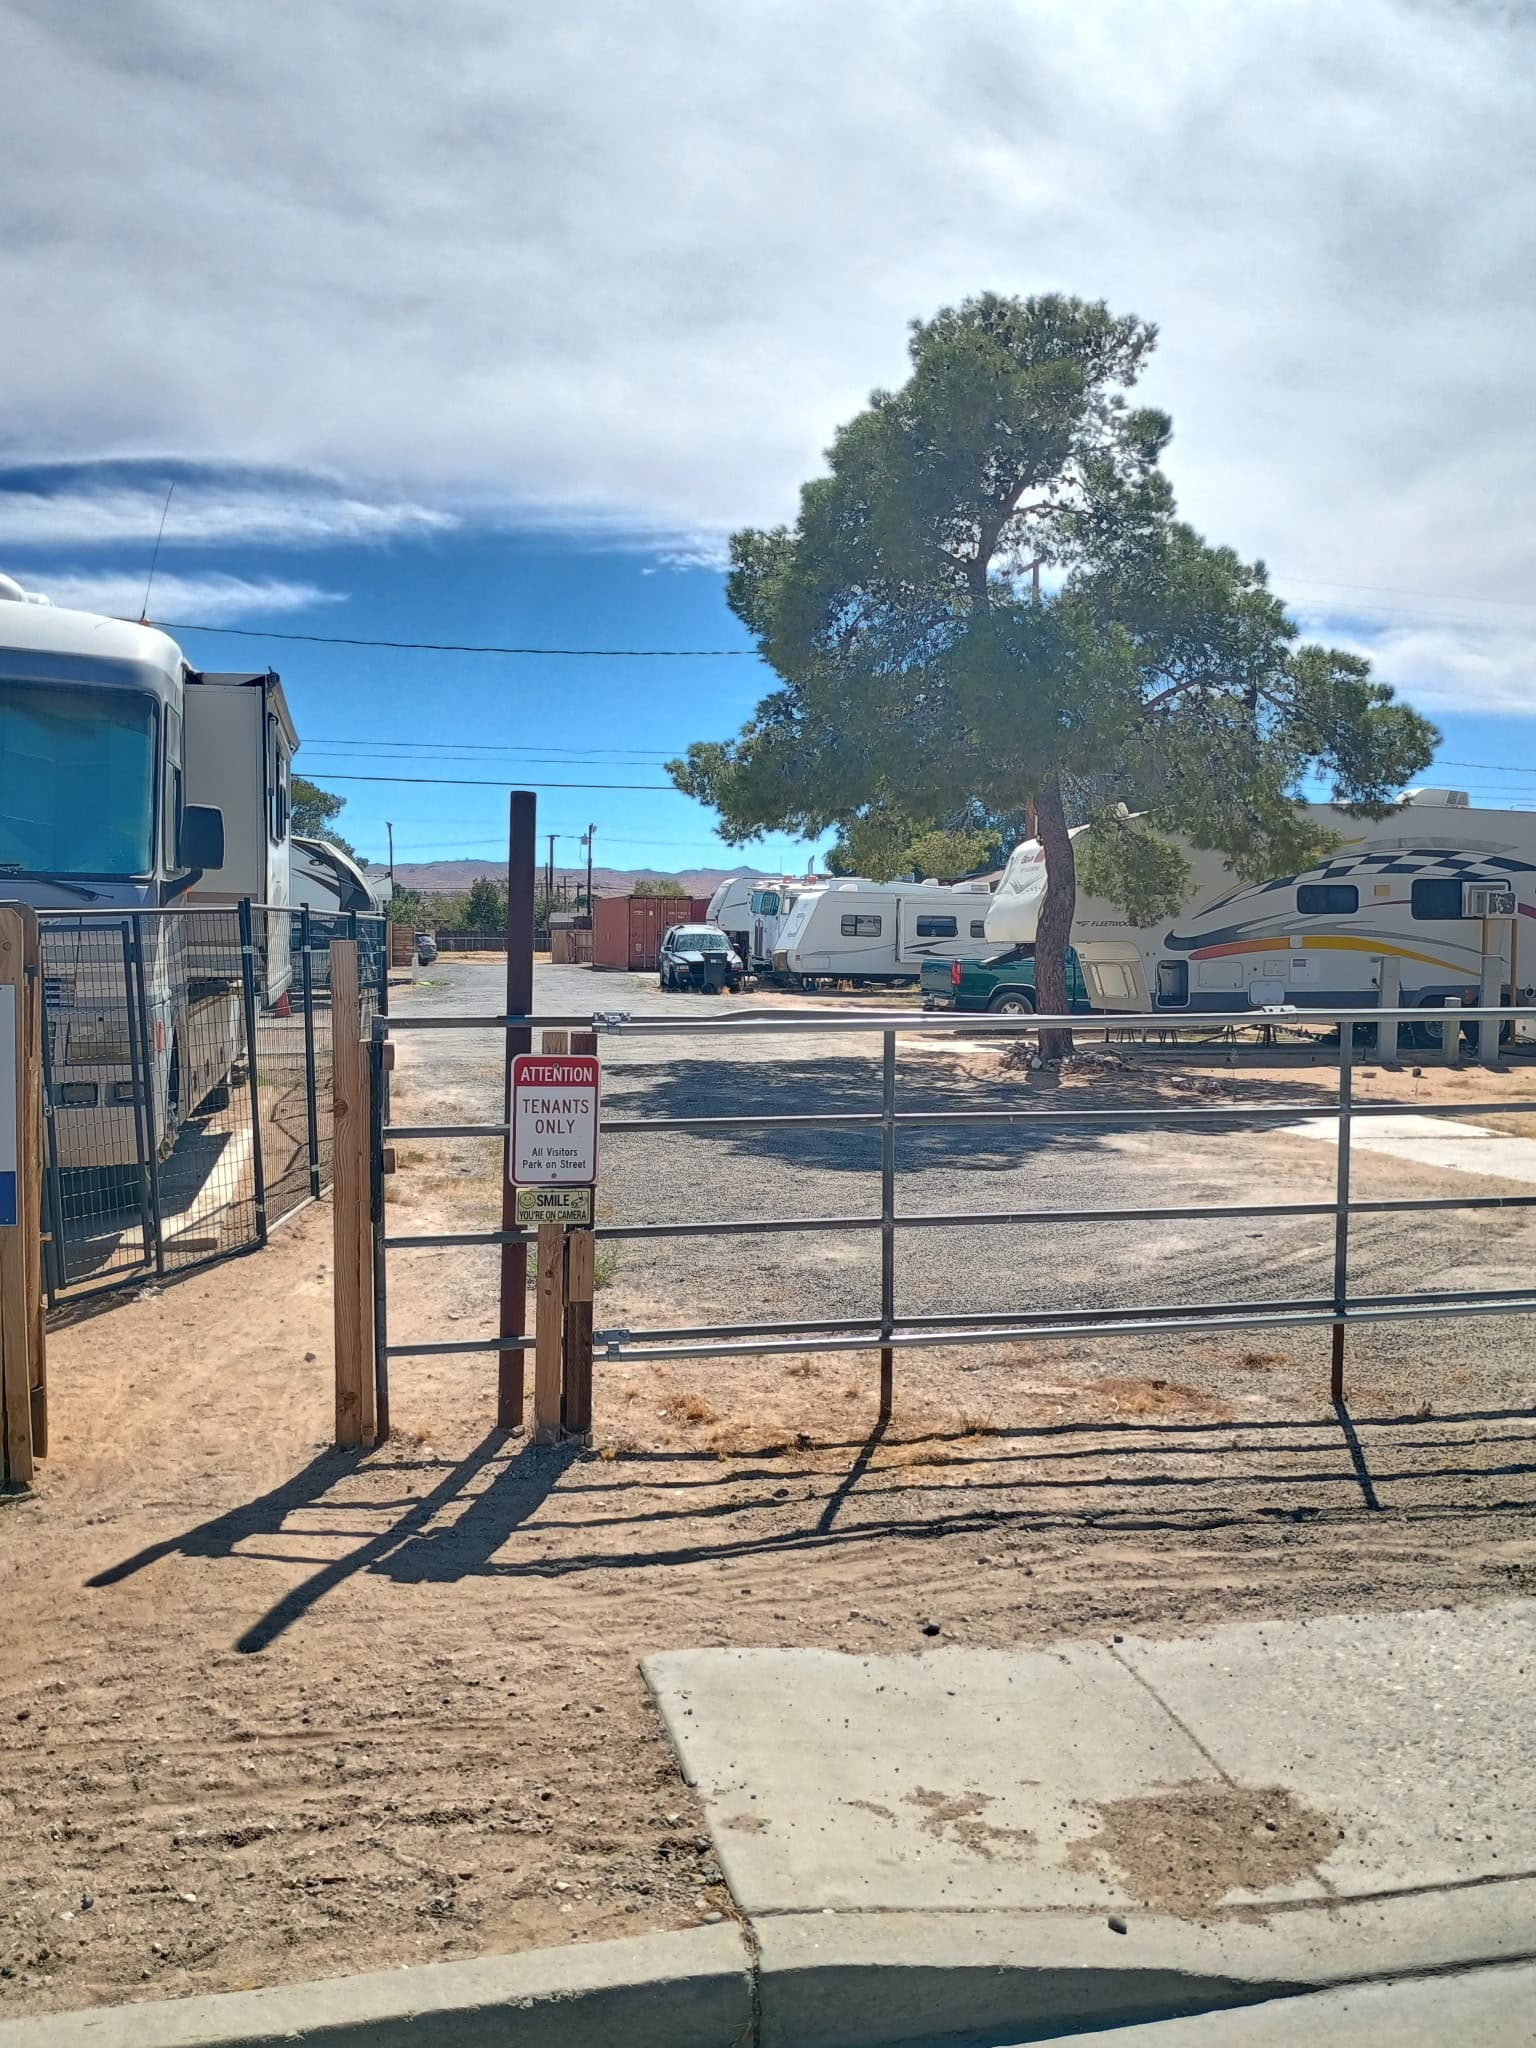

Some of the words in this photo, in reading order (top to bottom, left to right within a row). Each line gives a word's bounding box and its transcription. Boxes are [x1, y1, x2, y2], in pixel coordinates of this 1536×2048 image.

[520, 1066, 592, 1082] ATTENTION
[522, 1099, 589, 1114] TENANTS
[535, 1119, 575, 1134] ONLY
[532, 1147, 543, 1157] All
[547, 1147, 578, 1157] Visitors
[522, 1159, 543, 1169] Park
[545, 1161, 557, 1169] on
[560, 1159, 586, 1169] Street
[536, 1194, 570, 1207] SMILE
[519, 1210, 544, 1220] YOU'RE
[545, 1210, 556, 1220] ON
[557, 1210, 587, 1220] CAMERA
